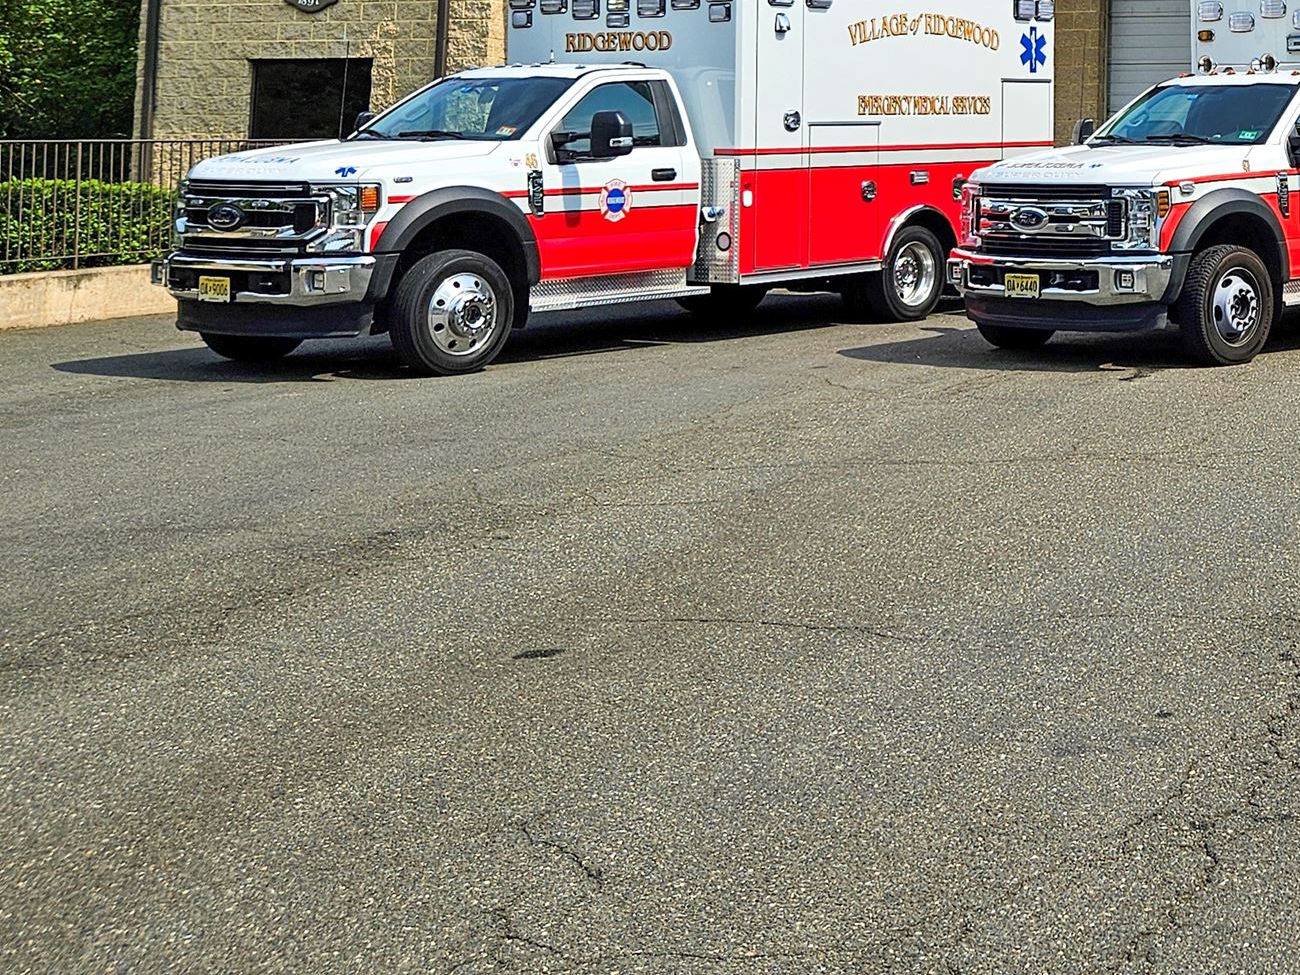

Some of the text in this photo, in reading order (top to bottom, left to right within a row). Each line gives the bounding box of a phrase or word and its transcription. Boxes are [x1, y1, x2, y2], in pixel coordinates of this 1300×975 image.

[565, 31, 672, 53] RIDGEWOOD
[848, 13, 1000, 51] VILLAGE of RIDGEWOOD
[857, 95, 991, 116] EMERGENCY MEDICAL SERVICES
[525, 152, 539, 169] 46
